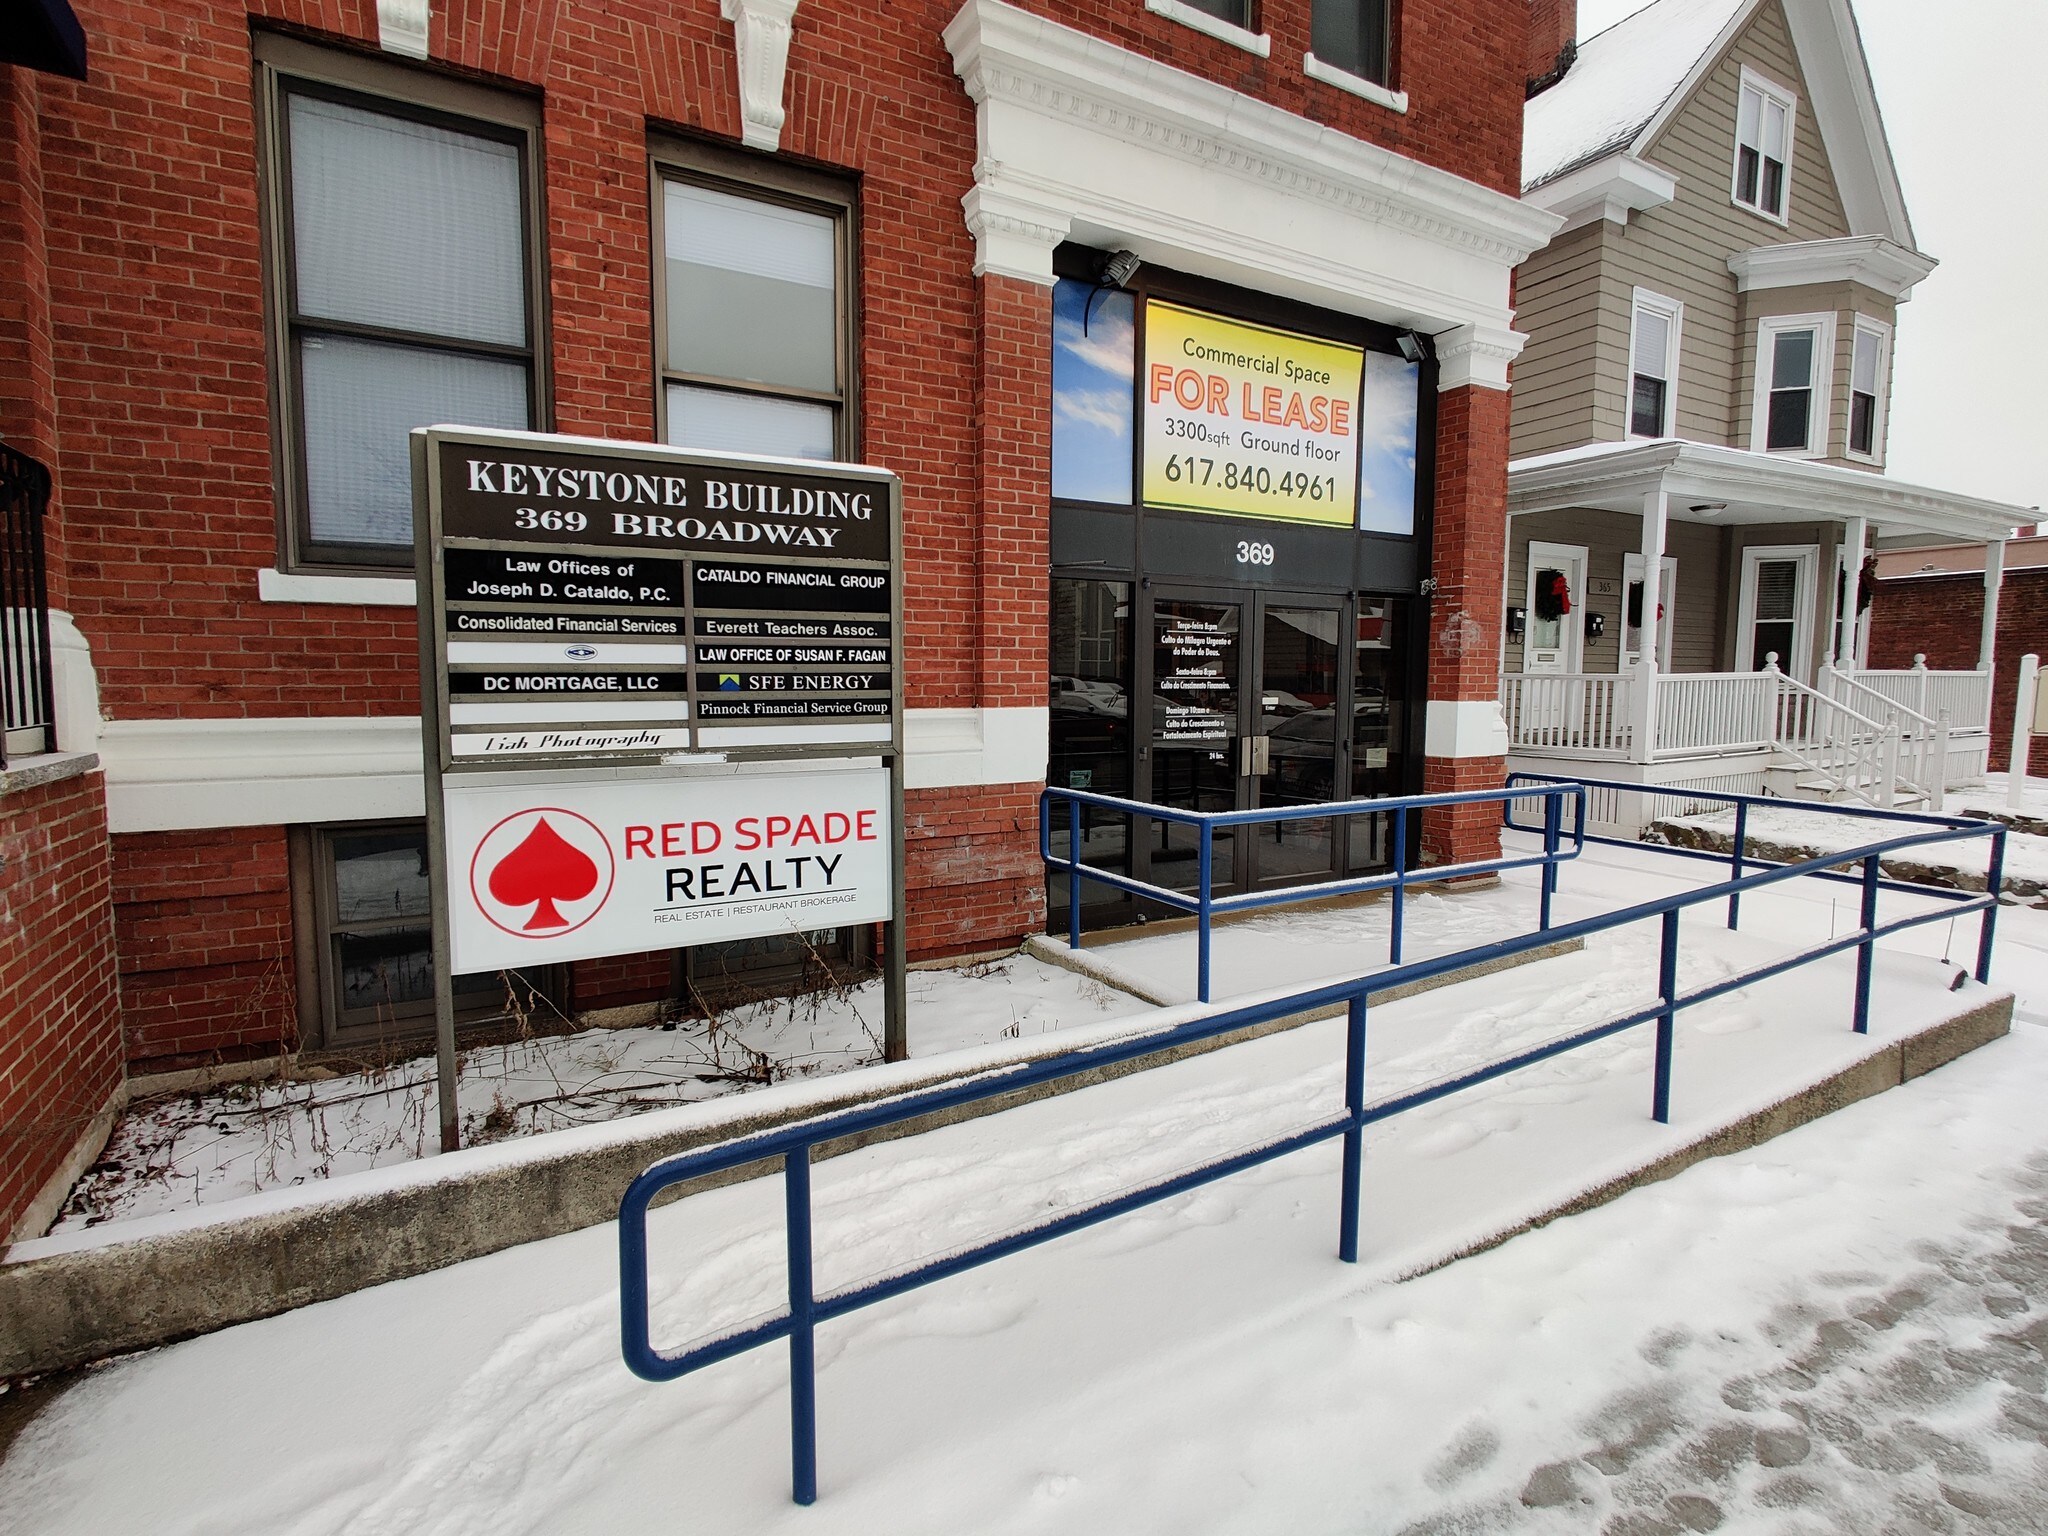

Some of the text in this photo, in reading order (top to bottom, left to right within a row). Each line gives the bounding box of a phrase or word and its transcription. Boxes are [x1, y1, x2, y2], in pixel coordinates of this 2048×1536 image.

[1183, 337, 1330, 385] Commercial Space
[1150, 363, 1350, 436] FOR LEASE
[1165, 418, 1341, 462] 3300sqft Ground floor
[1165, 454, 1335, 502] 617.840.4961
[466, 460, 872, 520] KEYSTONE BUILDING
[515, 507, 841, 548] 369 BROADWAY
[1236, 541, 1274, 565] 369
[506, 558, 634, 577] Law Offices of
[697, 569, 885, 589] CATALDO FINANCIAL GROUP
[1599, 581, 1611, 593] 365
[467, 581, 670, 602] Joseph D. Cataldo, P.C.
[458, 615, 677, 633] Consolidated Financial Services
[706, 621, 878, 636] Everett Teachers Assoc.
[699, 648, 886, 662] LAW OFFICE OF SUSAN F. FAGAN
[1181, 647, 1197, 655] Poder
[484, 676, 659, 691] DC MORTGAGE, LLC
[749, 675, 873, 690] SFE ENERGY
[700, 701, 888, 715] Pinnock Financial Service Group
[533, 730, 666, 748] Photography
[624, 809, 878, 860] RED SPADE
[665, 853, 843, 902] REALTY
[654, 913, 682, 923] REAL
[686, 909, 724, 920] ESTATE
[733, 900, 798, 915] RESTAURANT
[800, 894, 857, 907] BROKERAGE
